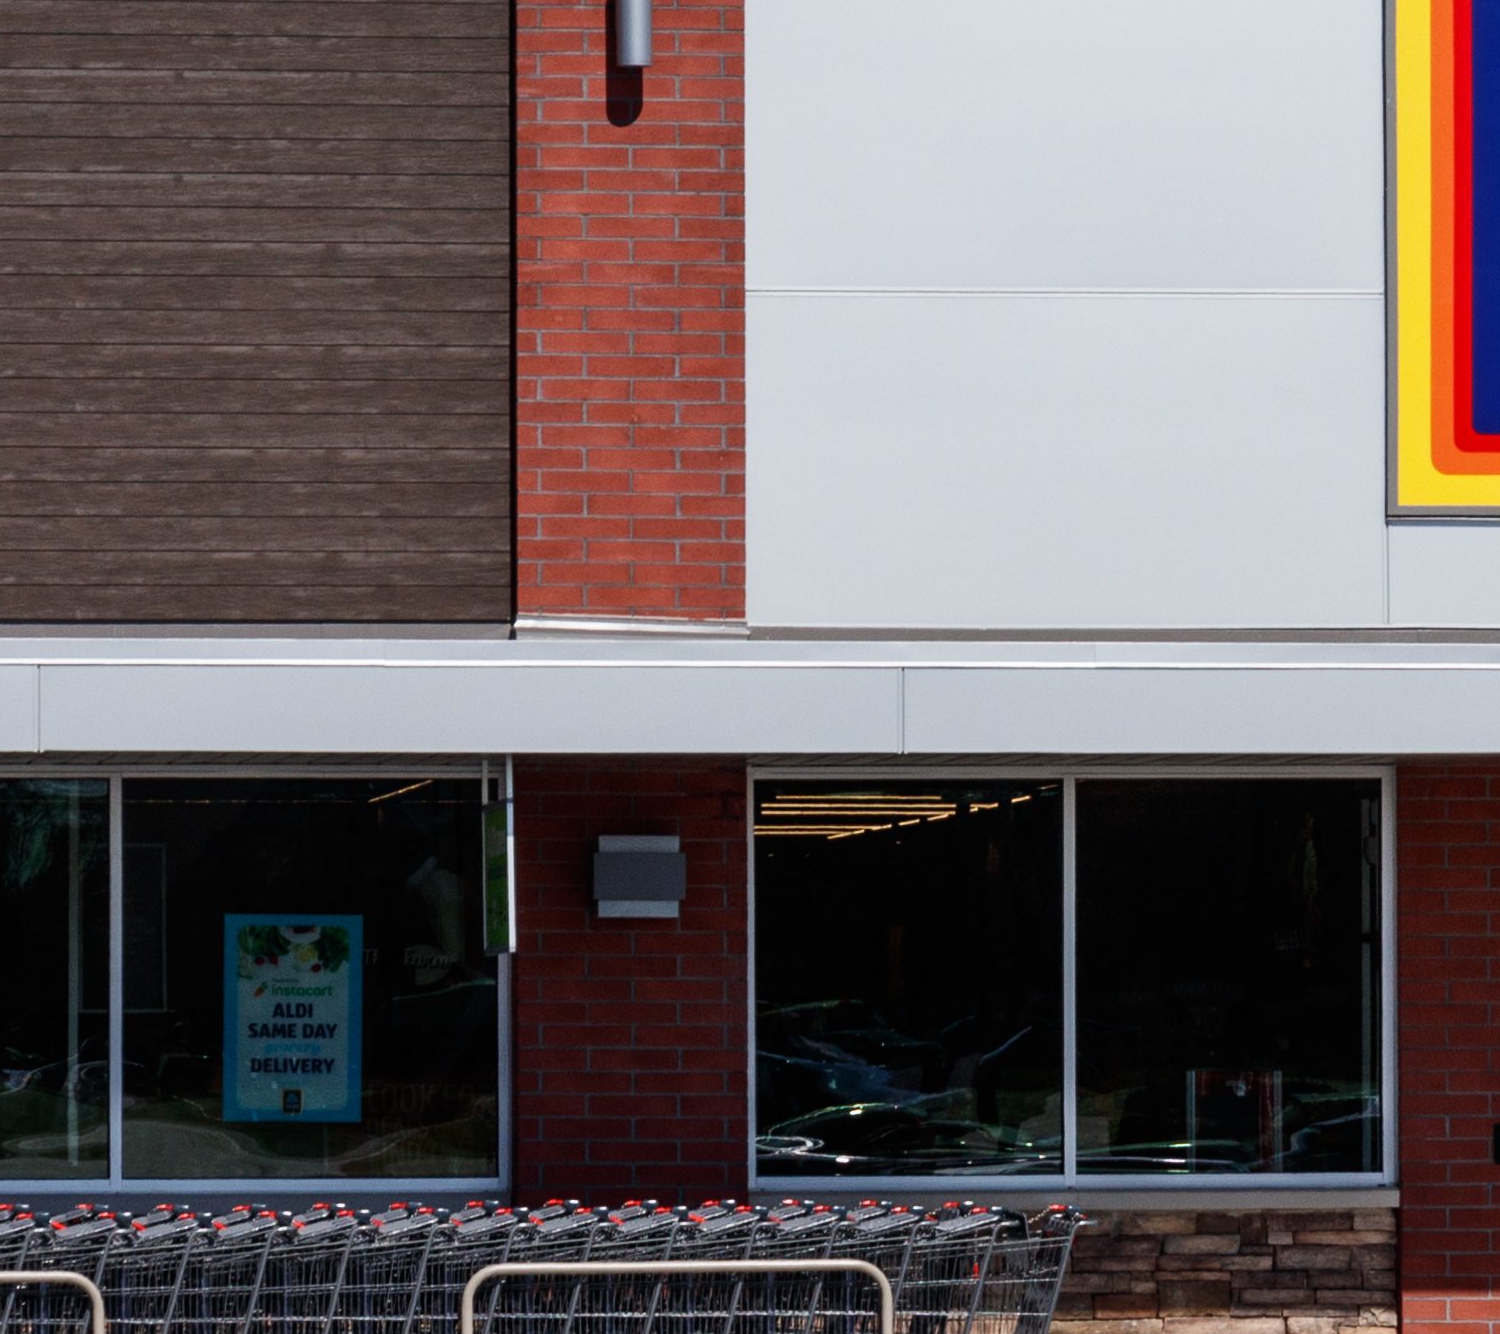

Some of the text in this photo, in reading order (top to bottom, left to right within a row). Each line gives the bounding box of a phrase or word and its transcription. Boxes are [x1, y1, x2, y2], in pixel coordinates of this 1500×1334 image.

[272, 1002, 313, 1019] ALDI
[248, 1023, 338, 1039] SAME DAY
[250, 1058, 335, 1074] DELIVERY
